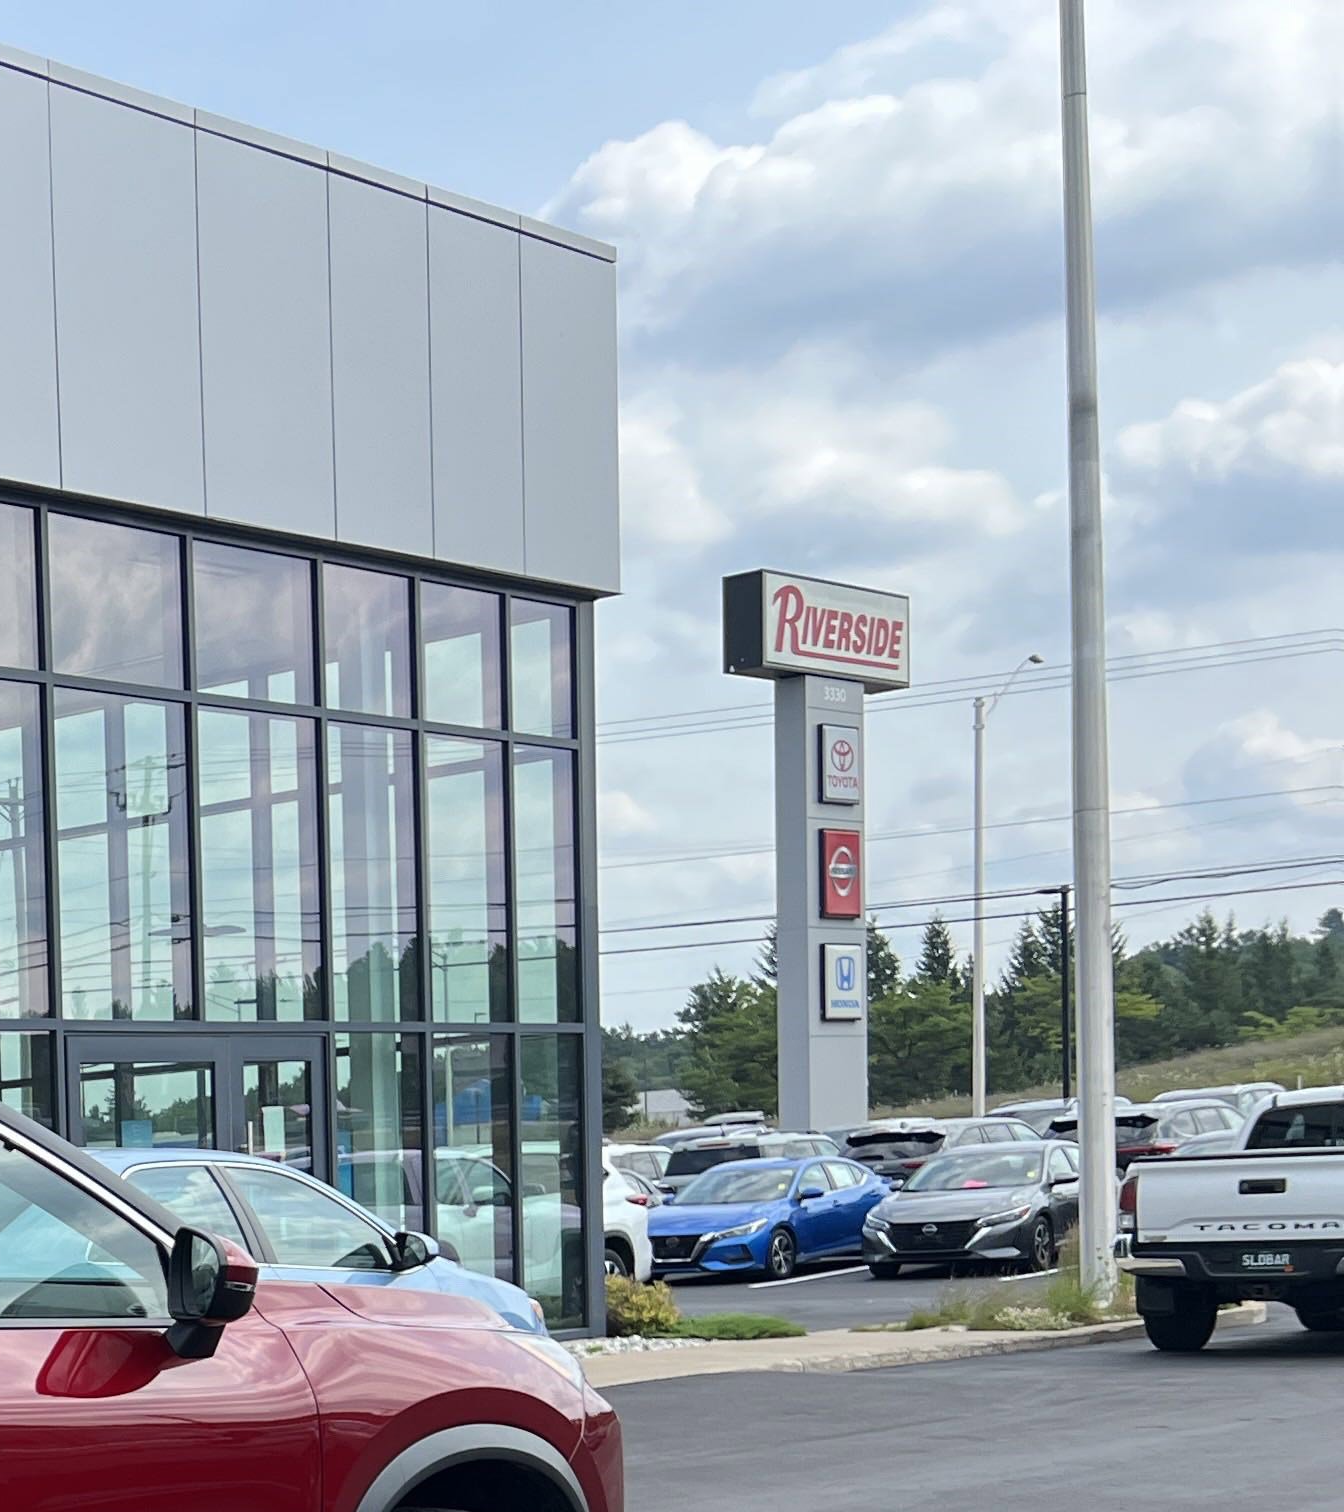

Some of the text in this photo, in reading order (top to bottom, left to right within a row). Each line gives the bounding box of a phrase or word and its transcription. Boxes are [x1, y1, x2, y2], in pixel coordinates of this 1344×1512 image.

[823, 686, 847, 702] 3330
[827, 775, 859, 789] TOYOTA
[1192, 1220, 1341, 1232] TACOMA
